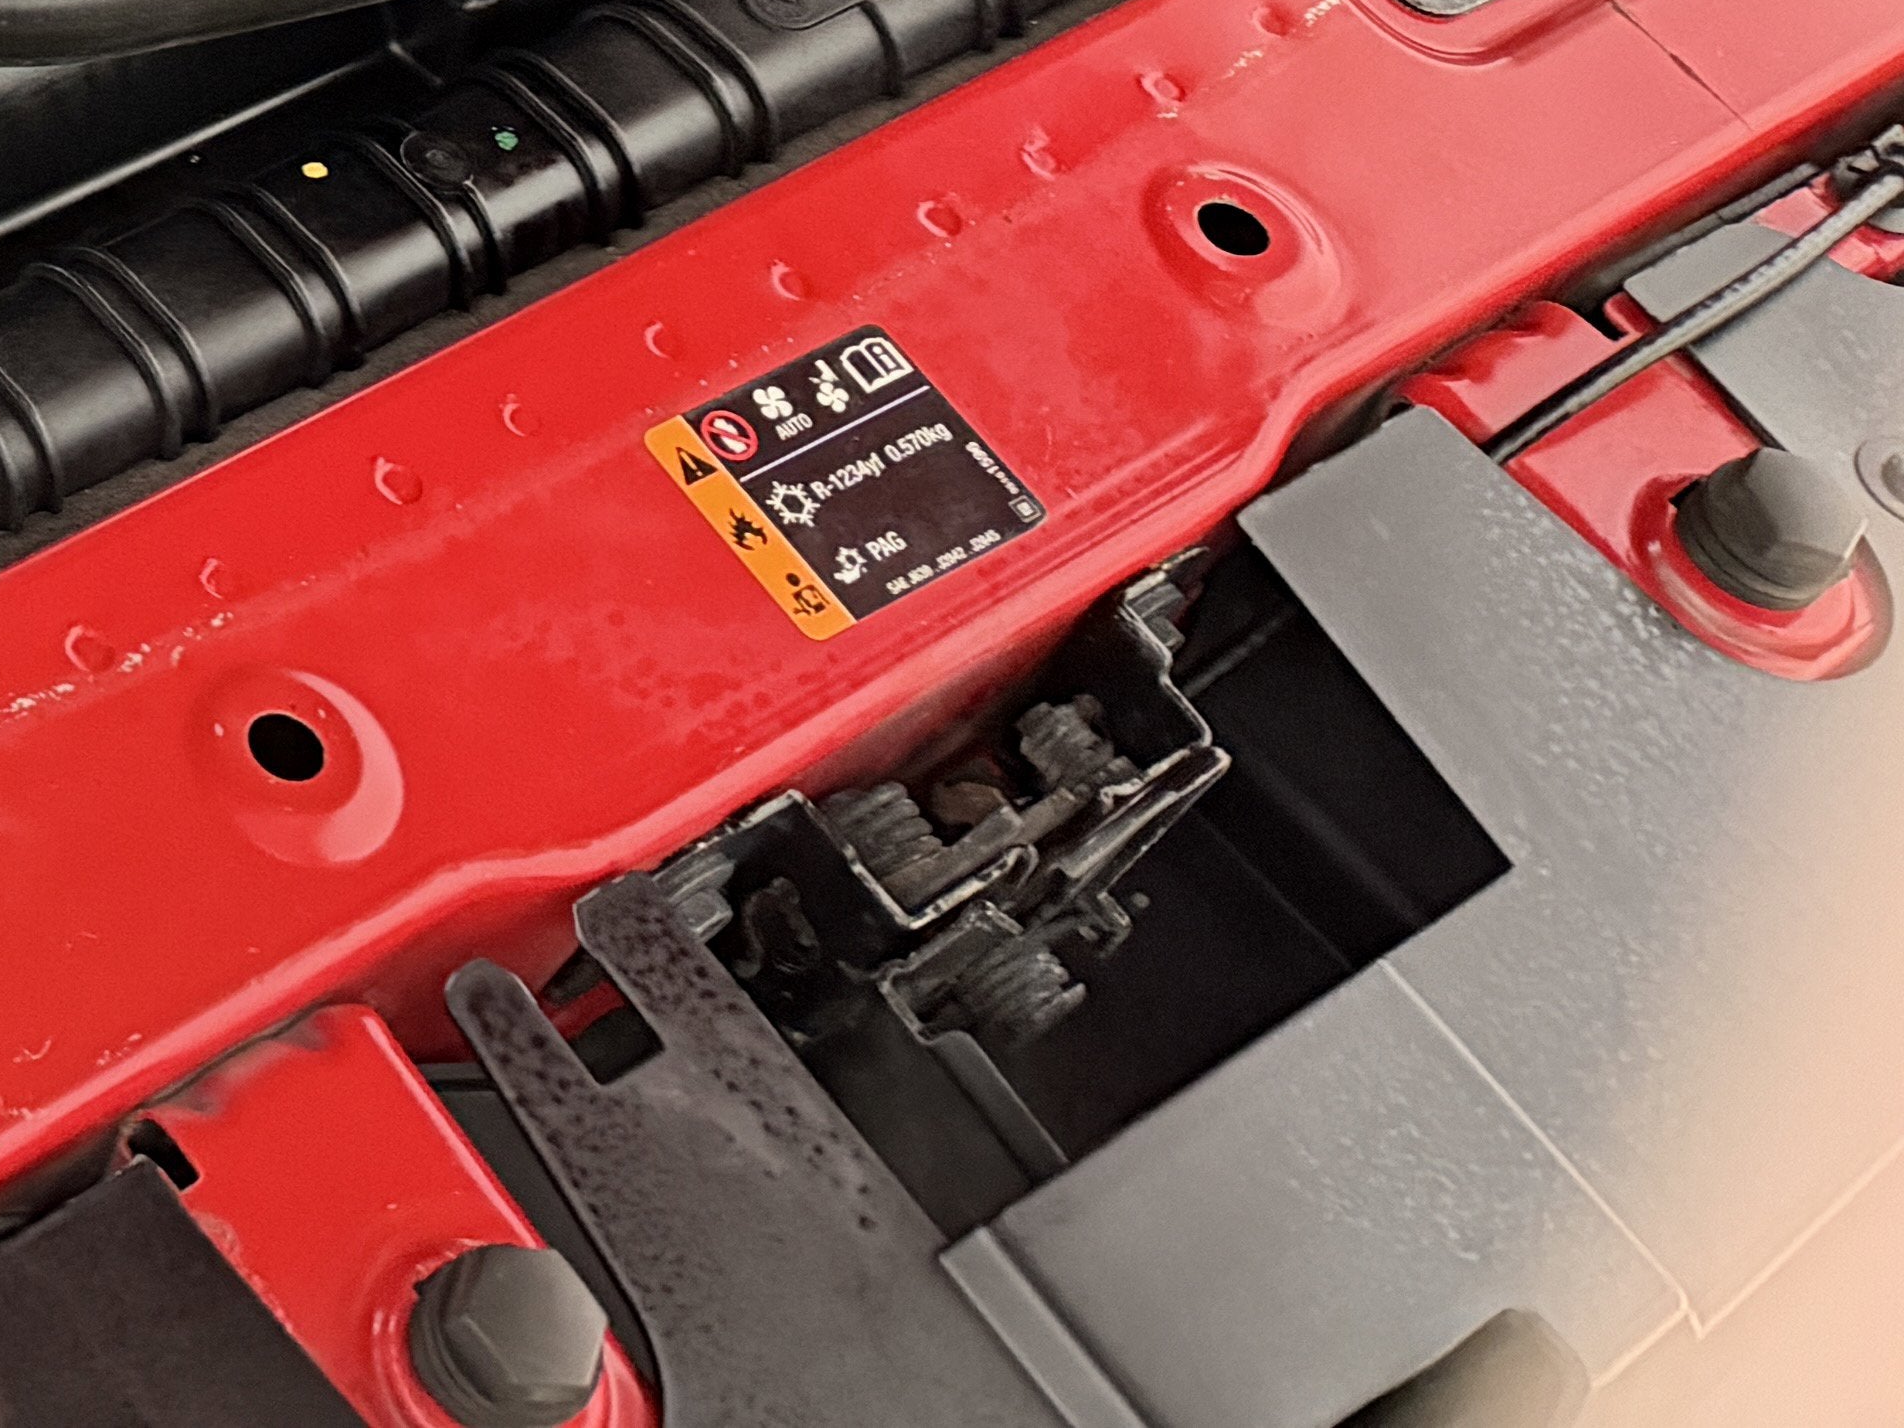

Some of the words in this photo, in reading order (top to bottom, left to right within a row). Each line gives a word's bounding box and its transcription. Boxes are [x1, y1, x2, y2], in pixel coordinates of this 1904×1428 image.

[775, 412, 814, 441] AUTO
[809, 451, 887, 501] R-1234yf
[887, 421, 954, 464] 0.570kg
[864, 530, 908, 561] PAG
